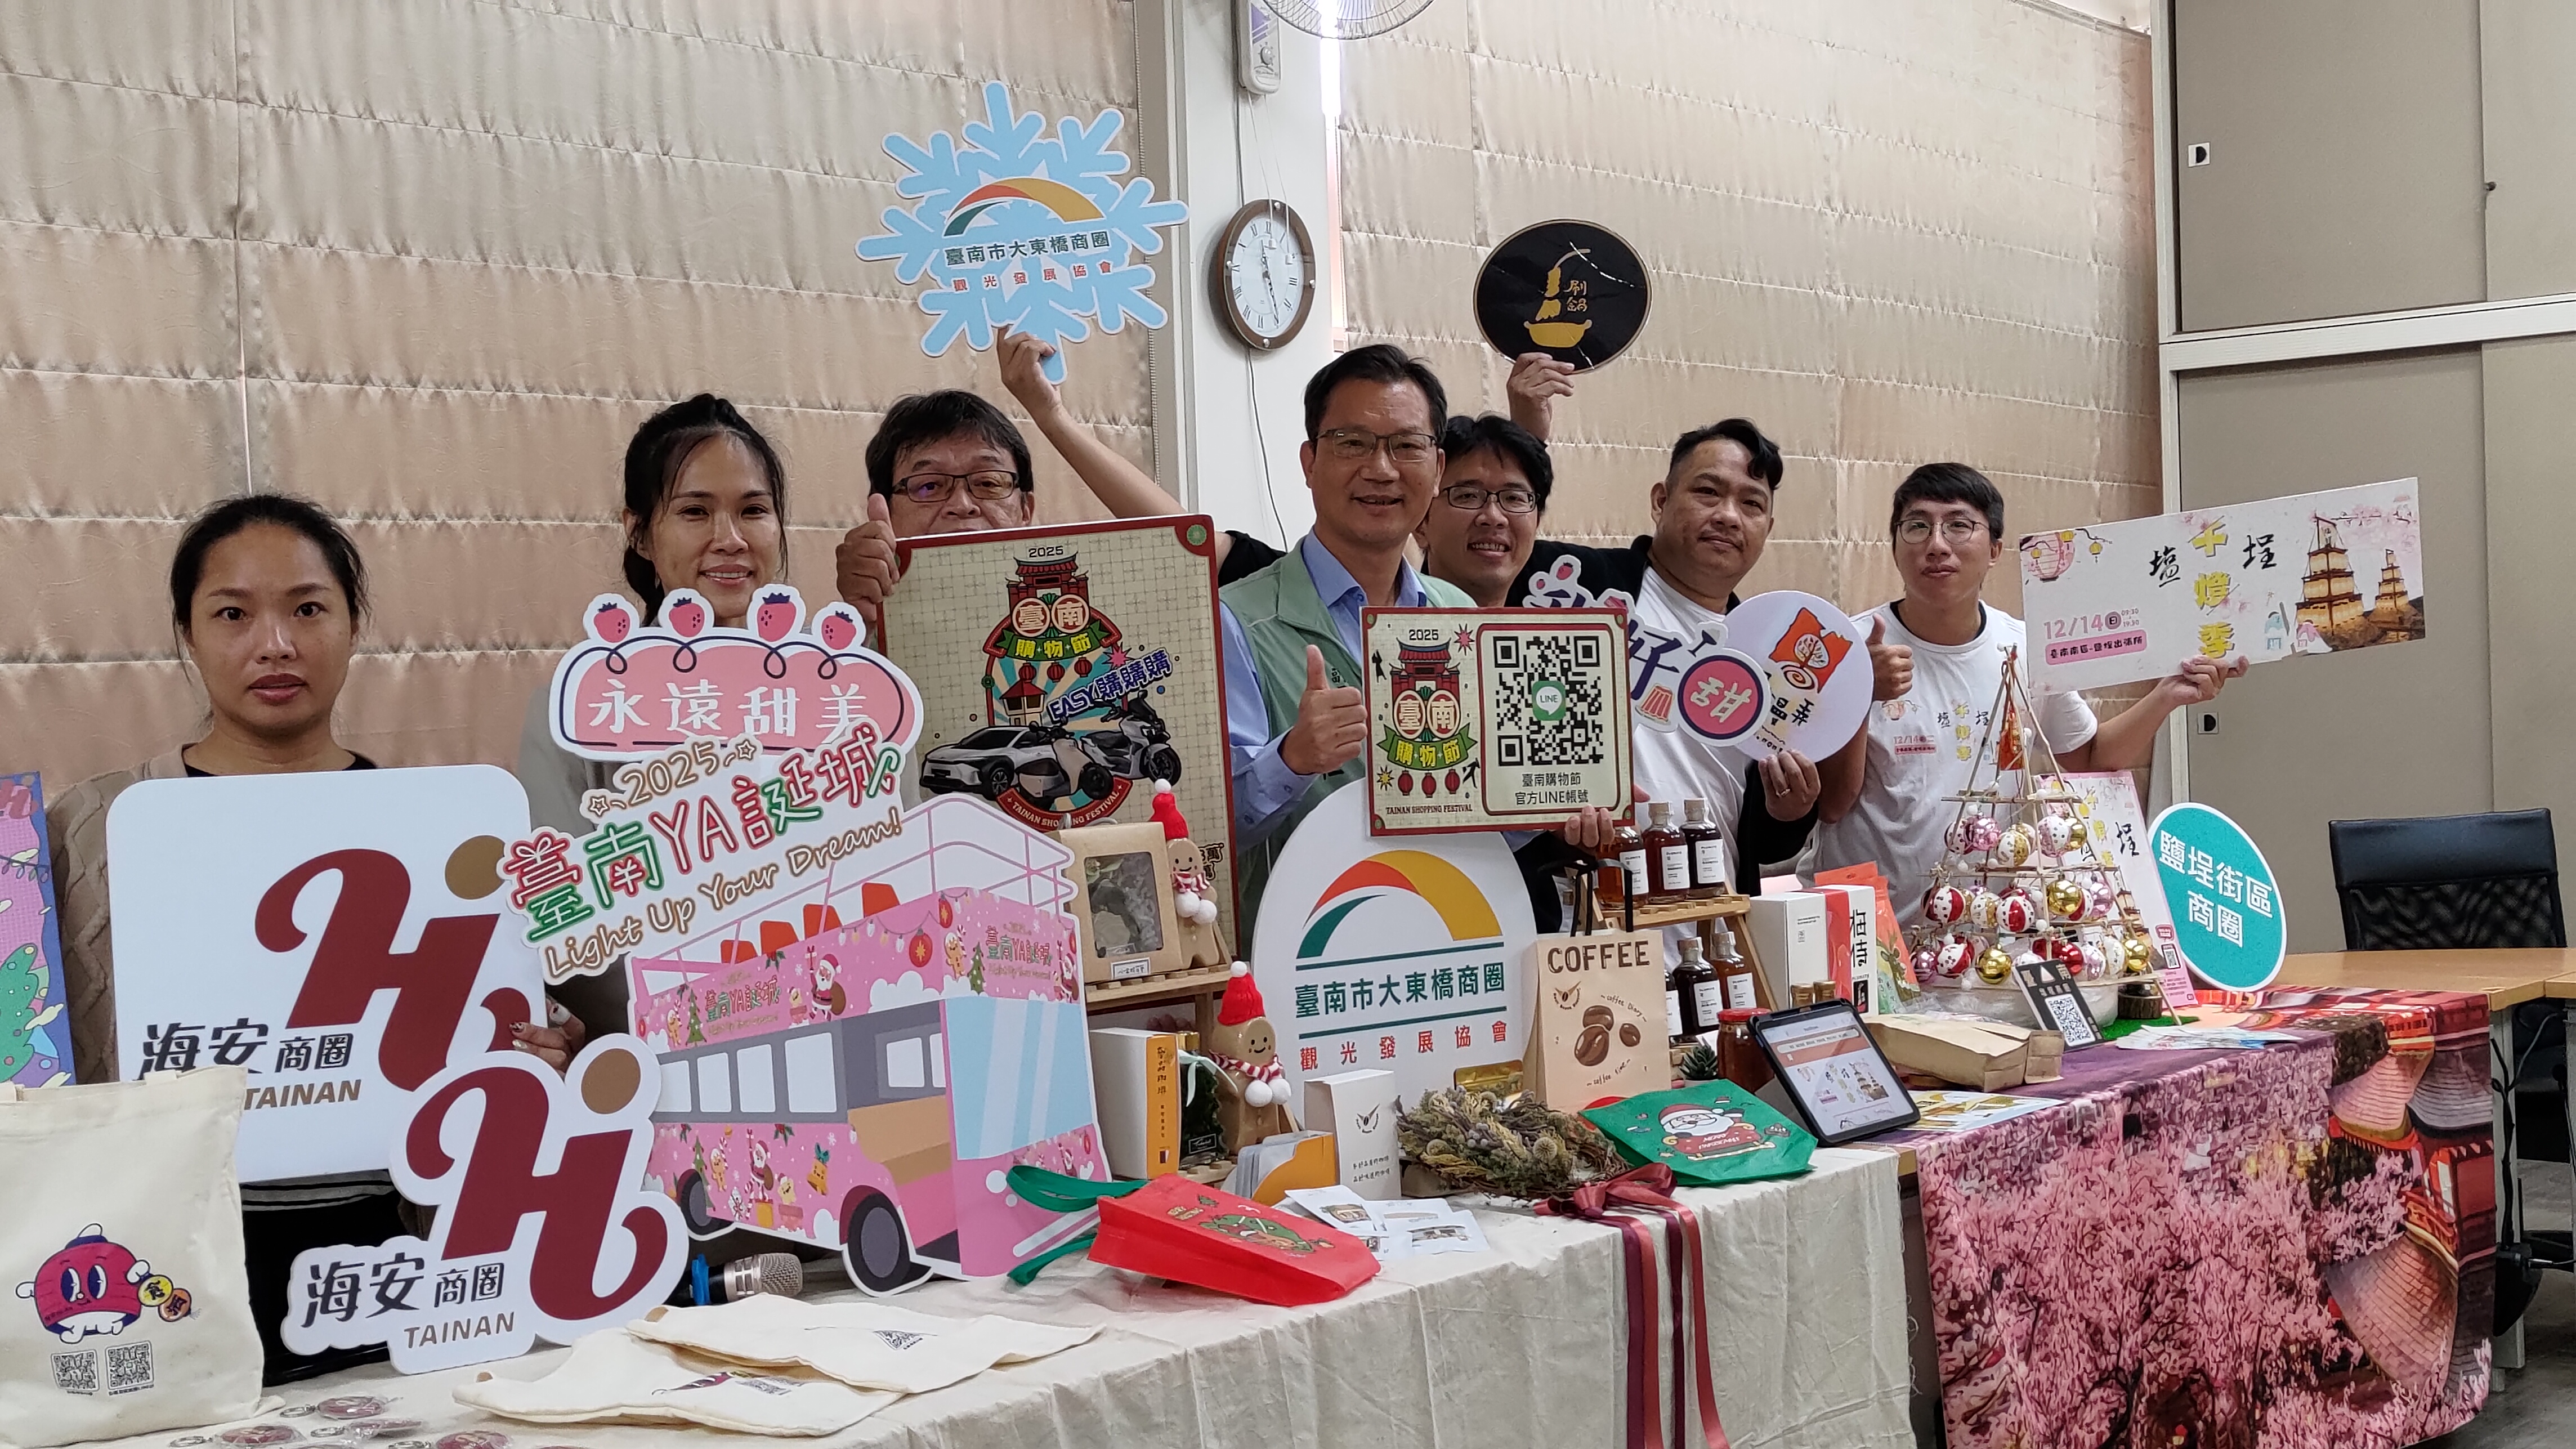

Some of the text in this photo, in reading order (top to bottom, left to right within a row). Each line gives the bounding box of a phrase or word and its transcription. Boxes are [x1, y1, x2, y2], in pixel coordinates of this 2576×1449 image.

[945, 231, 1110, 266] 臺南市大東橋商圈
[1028, 545, 1065, 559] 2025
[2243, 533, 2278, 570] 埕
[1017, 602, 1085, 629] 臺南
[2043, 614, 2104, 639] 12/14
[1016, 634, 1092, 659] 購物節
[1408, 629, 1439, 641] 2025
[588, 678, 868, 744] 永遠甜美
[1398, 699, 1456, 731] 臺南
[1540, 694, 1559, 703] LINE
[1395, 739, 1461, 767] 購物節
[622, 741, 717, 807] 2025
[1522, 772, 1581, 787] 臺南購物節
[1012, 790, 1120, 828] TAINAN SHONG FESTIVAL
[1385, 806, 1411, 815] TAINAN
[1515, 789, 1589, 806] 官方LINE帳號
[2158, 829, 2273, 919] 鹽埕街區
[545, 808, 902, 978] Light Up Your Dream!
[2186, 889, 2243, 949] 商圈
[1547, 940, 1651, 974] COFFEE
[1295, 961, 1505, 1019] 臺南市大東橋商圈
[1300, 1020, 1508, 1072] 觀光發展協會
[245, 1079, 361, 1111] TAINAN
[301, 1253, 505, 1328] 海安商圈
[404, 1312, 515, 1349] TAINAN
